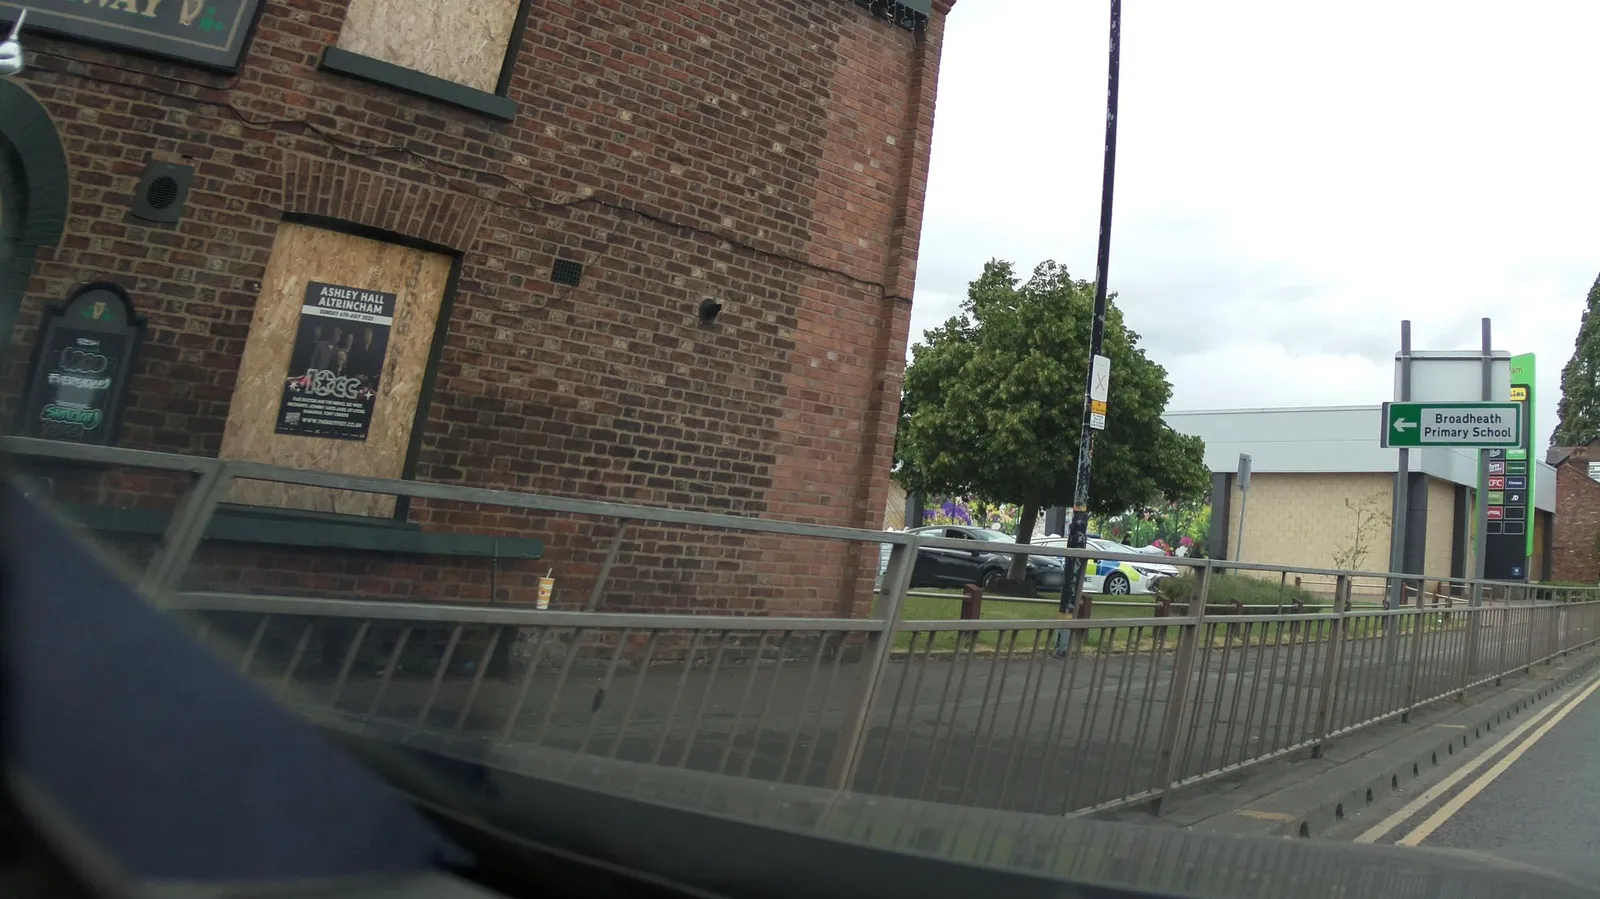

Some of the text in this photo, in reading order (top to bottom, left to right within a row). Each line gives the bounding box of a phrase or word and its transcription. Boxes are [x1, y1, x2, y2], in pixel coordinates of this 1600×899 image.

[320, 286, 384, 305] ASHLEY HALL
[318, 296, 383, 315] ALTRINCHAM
[1435, 413, 1502, 424] Broadheath
[1424, 426, 1512, 439] Primary School
[1488, 479, 1503, 487] KFC
